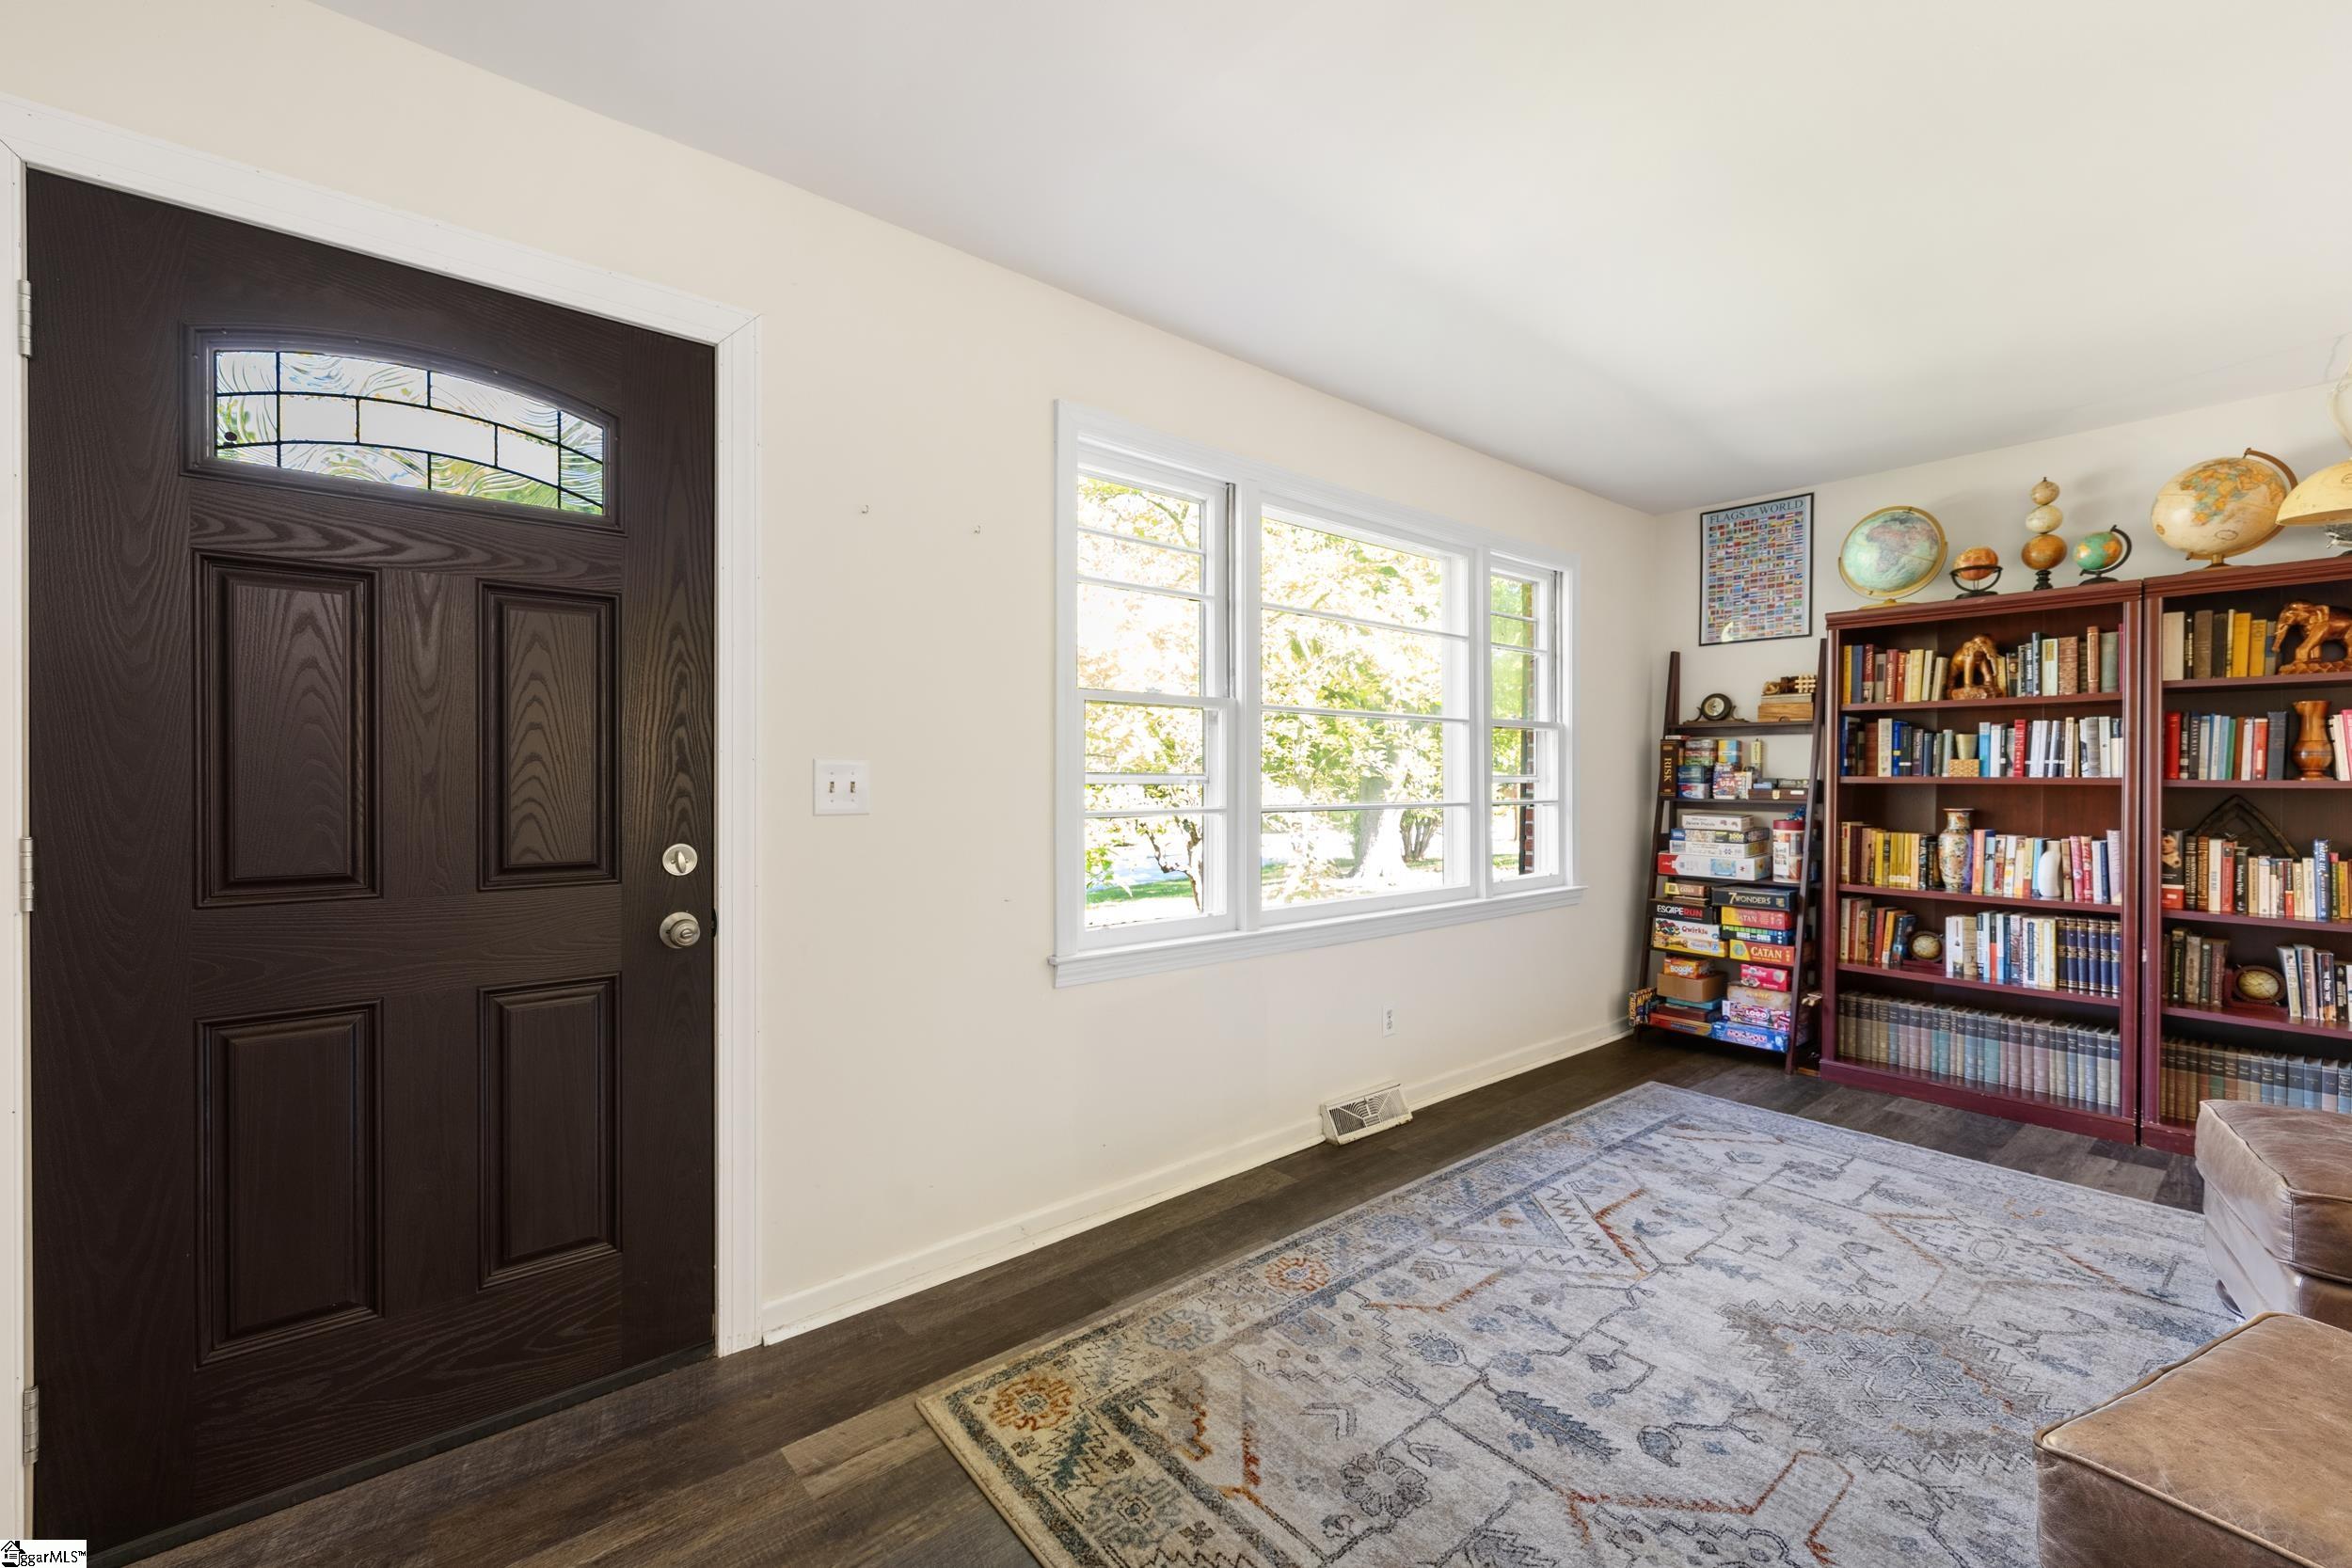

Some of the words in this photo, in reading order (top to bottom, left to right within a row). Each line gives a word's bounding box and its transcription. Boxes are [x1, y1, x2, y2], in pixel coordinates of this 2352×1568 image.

[1709, 510, 1745, 524] FLAGS
[1759, 499, 1804, 515] WORLD
[1663, 757, 1673, 783] RISK
[1720, 779, 1735, 787] USA
[1728, 893, 1738, 904] 7
[1736, 895, 1771, 904] WONDERS
[1751, 946, 1782, 959] CATAN
[1670, 965, 1692, 975] Boggle
[1746, 1009, 1767, 1019] LOGO
[1727, 1028, 1767, 1043] MONOPOLY
